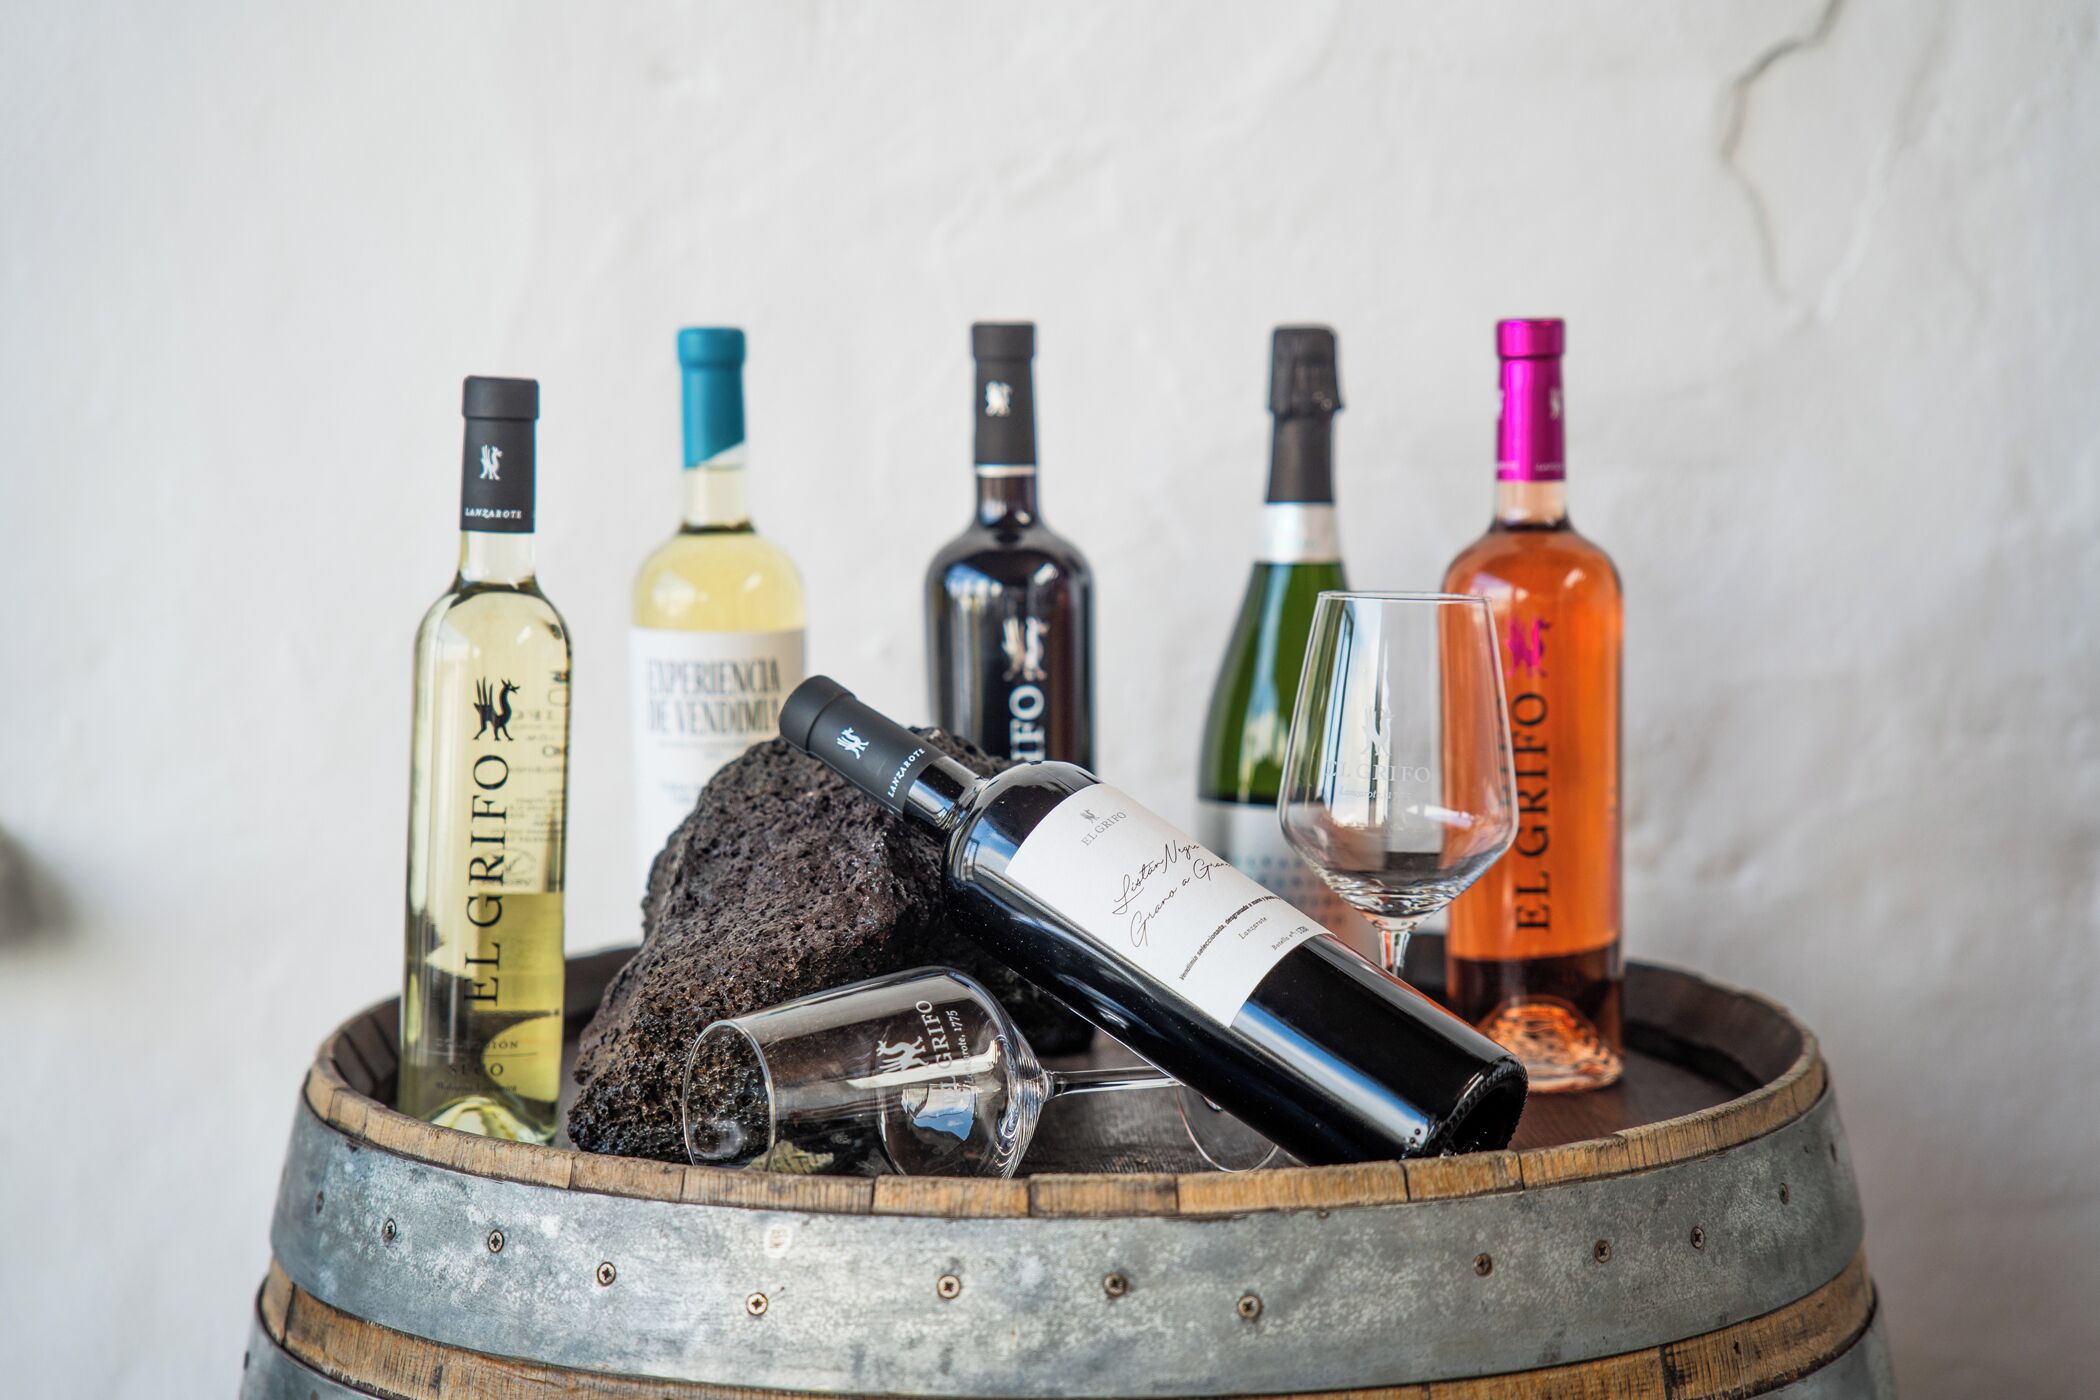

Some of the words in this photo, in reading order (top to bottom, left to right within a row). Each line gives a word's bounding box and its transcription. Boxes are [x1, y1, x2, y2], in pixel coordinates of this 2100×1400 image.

[464, 507, 523, 520] LANZAROTE
[648, 657, 781, 694] EXPERIENCIA
[648, 699, 667, 735] DE
[1009, 684, 1045, 761] IFO
[887, 748, 926, 798] LANZAROTE
[1511, 693, 1550, 858] GRIFO
[466, 753, 510, 928] GRIFO
[1081, 832, 1097, 847] EL
[1094, 811, 1128, 834] GRIFO
[1515, 871, 1551, 932] EL
[464, 942, 500, 1007] EL
[1179, 956, 1199, 981] Vendimia
[915, 1000, 953, 1070] GRIFO
[945, 1009, 964, 1032] 1775
